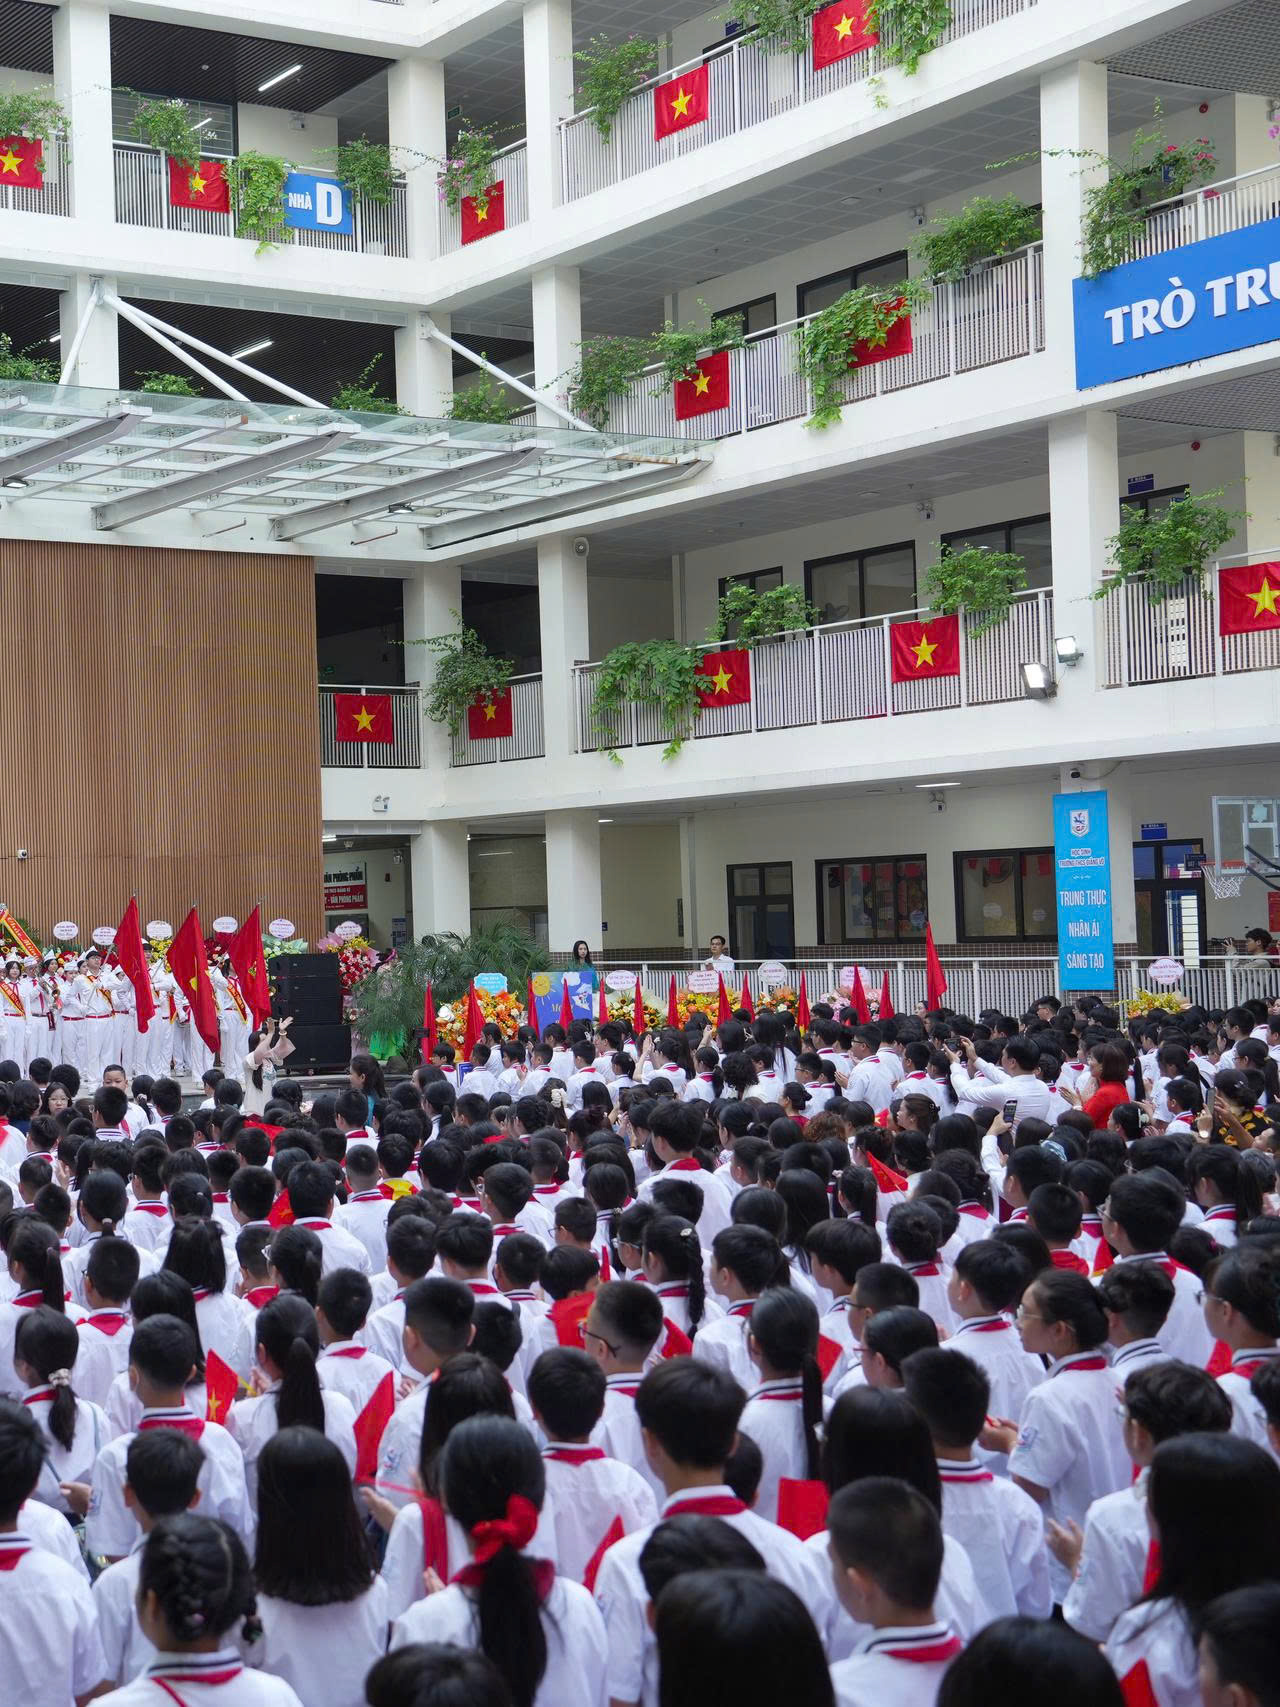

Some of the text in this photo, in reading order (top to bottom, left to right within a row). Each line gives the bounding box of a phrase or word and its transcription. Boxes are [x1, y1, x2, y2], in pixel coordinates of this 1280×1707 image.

[288, 182, 343, 226] NHÀ D
[1104, 276, 1196, 345] TRÒ
[1060, 889, 1107, 908] TRUNG THỰC
[1068, 918, 1100, 937] NHÂN ÁI
[1066, 950, 1105, 972] SÁNG TẠO
